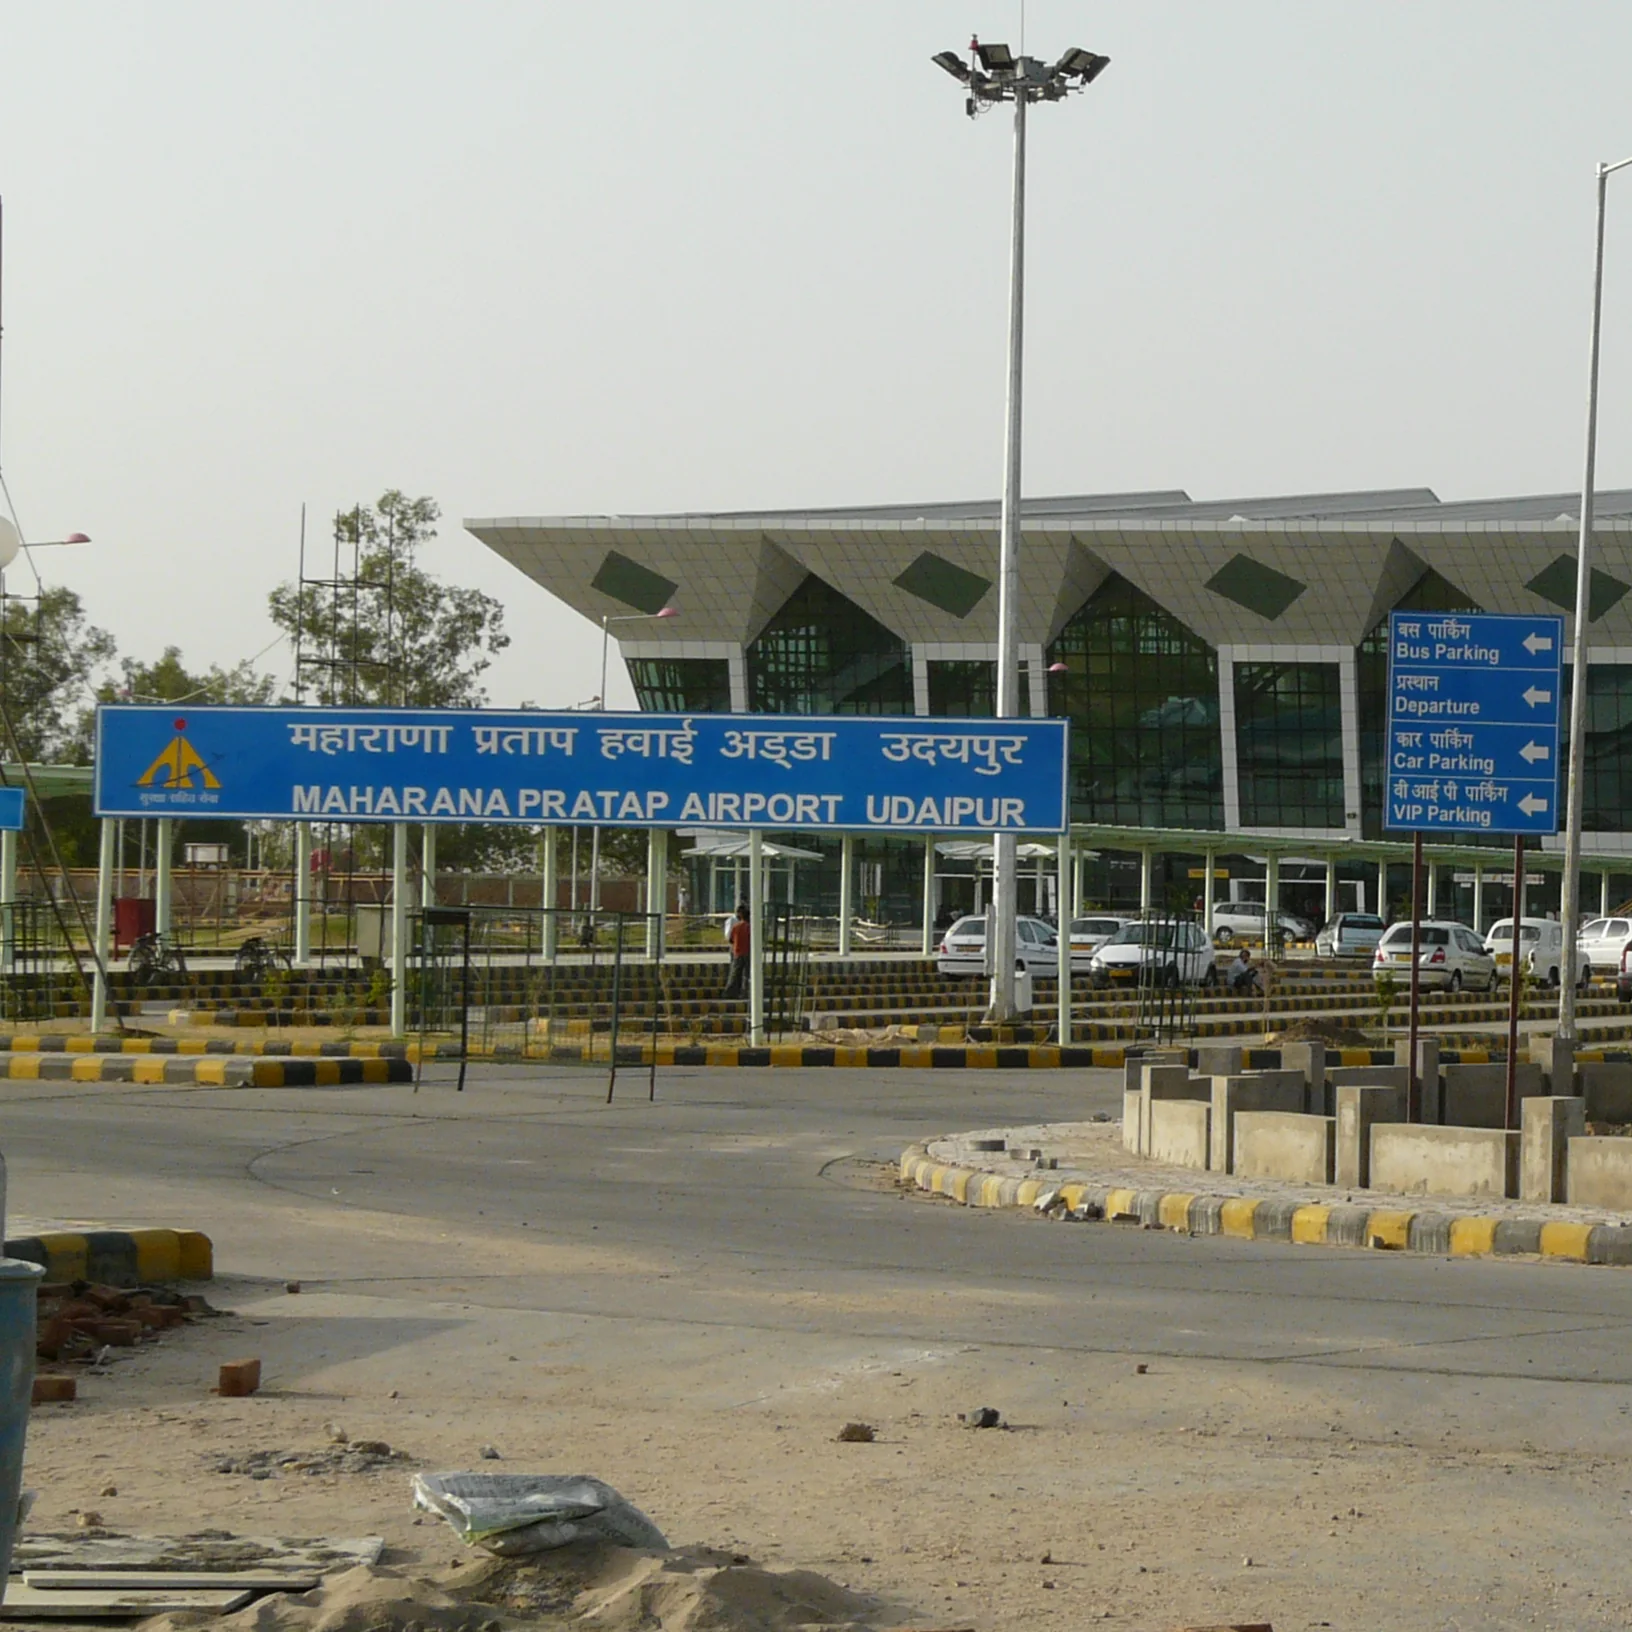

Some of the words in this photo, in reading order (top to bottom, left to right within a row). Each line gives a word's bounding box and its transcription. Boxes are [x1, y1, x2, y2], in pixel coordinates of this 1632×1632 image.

[1397, 622, 1421, 639] बस
[1396, 642, 1430, 659] Bus
[1435, 643, 1500, 665] Parking
[1396, 674, 1440, 692] प्रस्थान
[1395, 696, 1480, 717] Departure
[288, 723, 453, 755] महाराणा
[471, 725, 578, 756] प्रताप
[597, 718, 698, 765] हवाई
[880, 731, 1028, 775] उदयपुर
[1395, 731, 1423, 748] कार
[1394, 752, 1425, 769] Car
[1429, 753, 1495, 775] Parking
[1393, 779, 1409, 800] वी
[1411, 780, 1440, 801] आई
[1443, 780, 1459, 801] पी
[292, 784, 510, 817] MAHARANA
[518, 788, 669, 820] PRATAP
[680, 792, 843, 824] AIRPORT
[865, 795, 1026, 827] UDAIPUR
[1393, 804, 1423, 821] VIP
[1427, 805, 1491, 826] Parking
